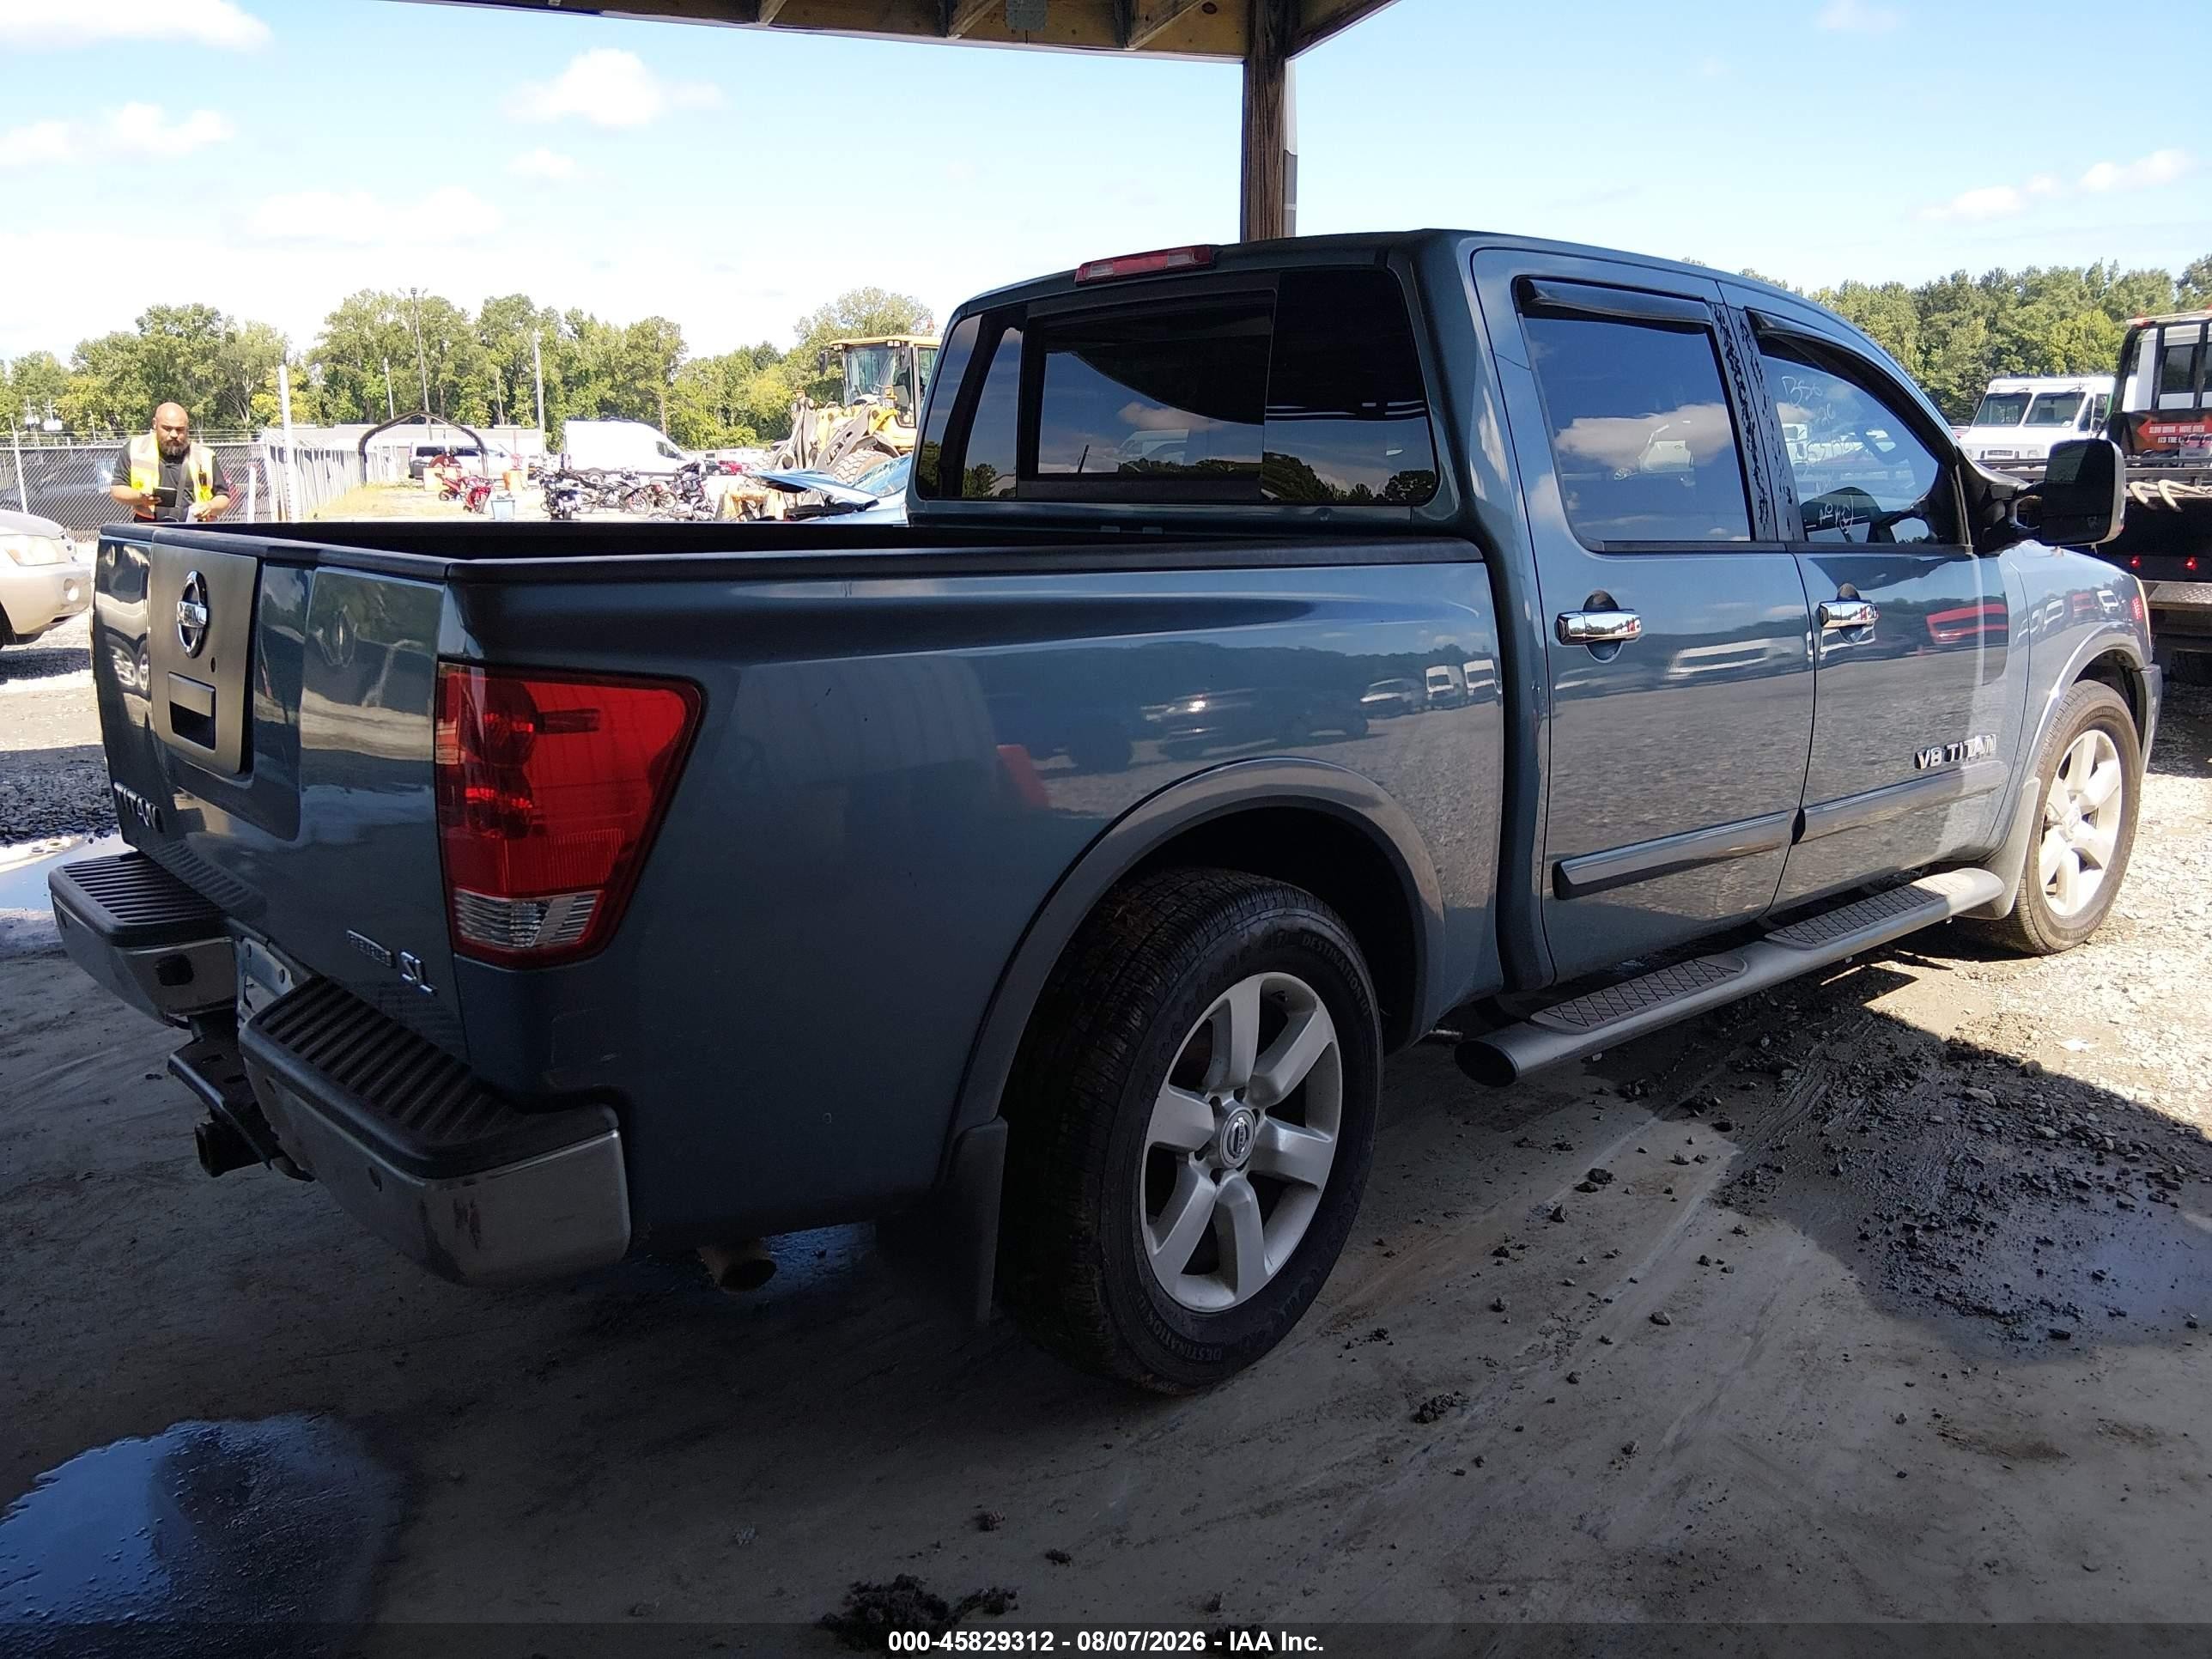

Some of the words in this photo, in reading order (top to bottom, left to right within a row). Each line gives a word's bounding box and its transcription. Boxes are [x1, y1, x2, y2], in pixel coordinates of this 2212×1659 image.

[1916, 747, 1943, 769] V8
[1945, 733, 1997, 763] TITAN
[113, 781, 161, 830] TITAN
[400, 951, 434, 994] SL
